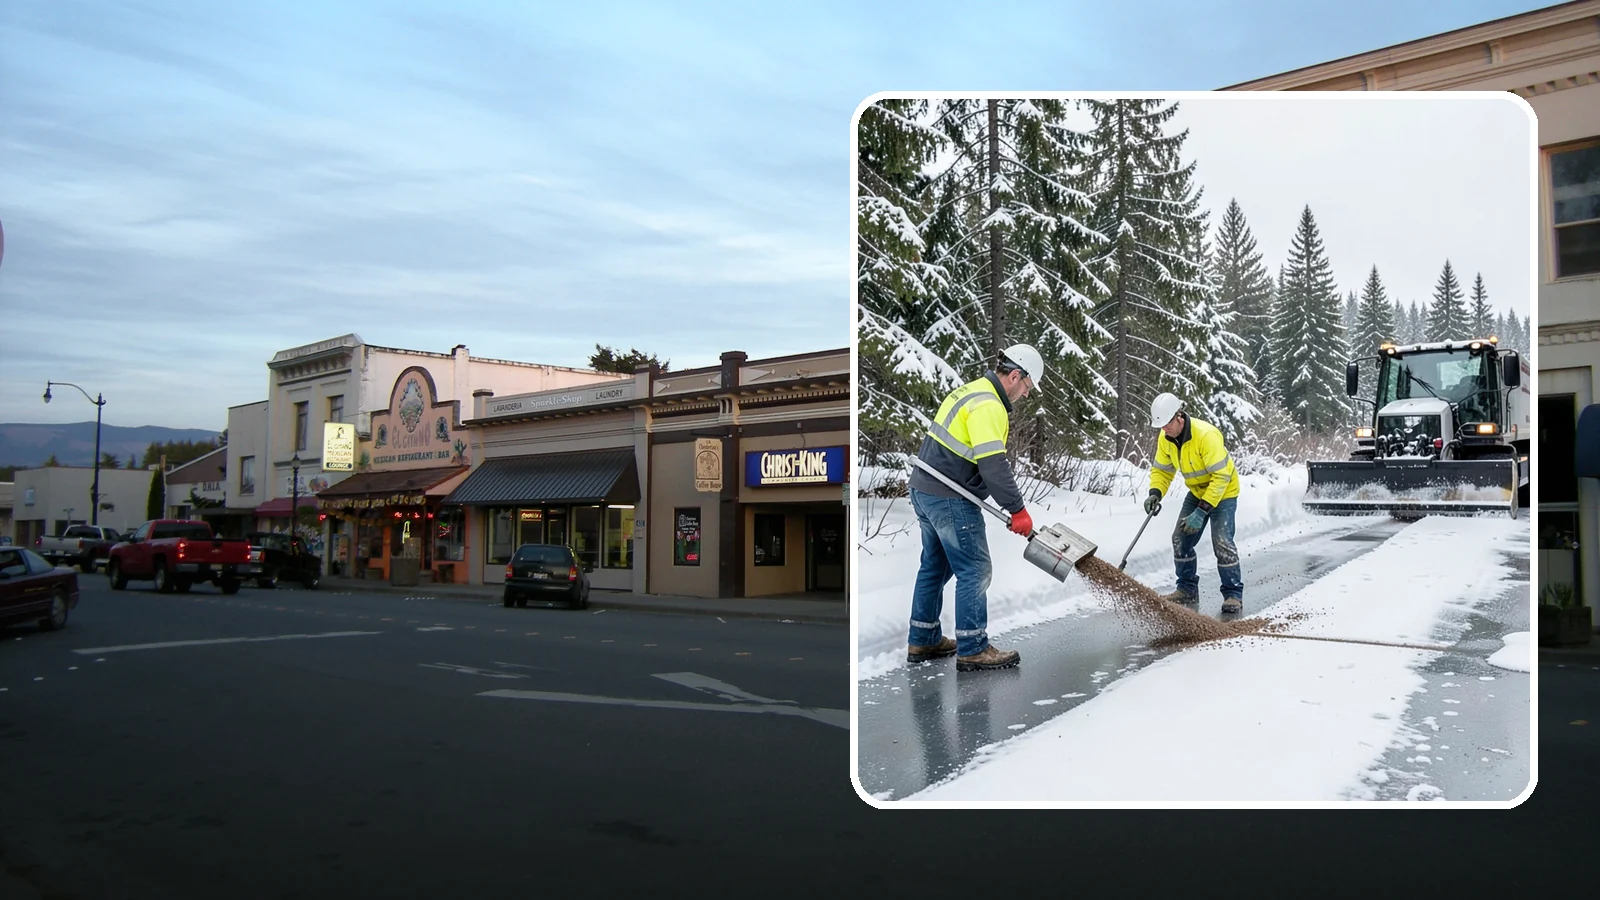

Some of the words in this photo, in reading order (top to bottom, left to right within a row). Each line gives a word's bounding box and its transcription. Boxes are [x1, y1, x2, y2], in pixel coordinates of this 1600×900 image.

[561, 394, 582, 405] Shop
[595, 389, 623, 400] LAUNDRY
[493, 402, 522, 412] LAVANDERIA
[373, 454, 396, 464] MEXICAN
[398, 452, 433, 462] RESTAURANT
[438, 450, 450, 459] BAR
[761, 452, 797, 478] CHRIST
[799, 450, 827, 476] KING
